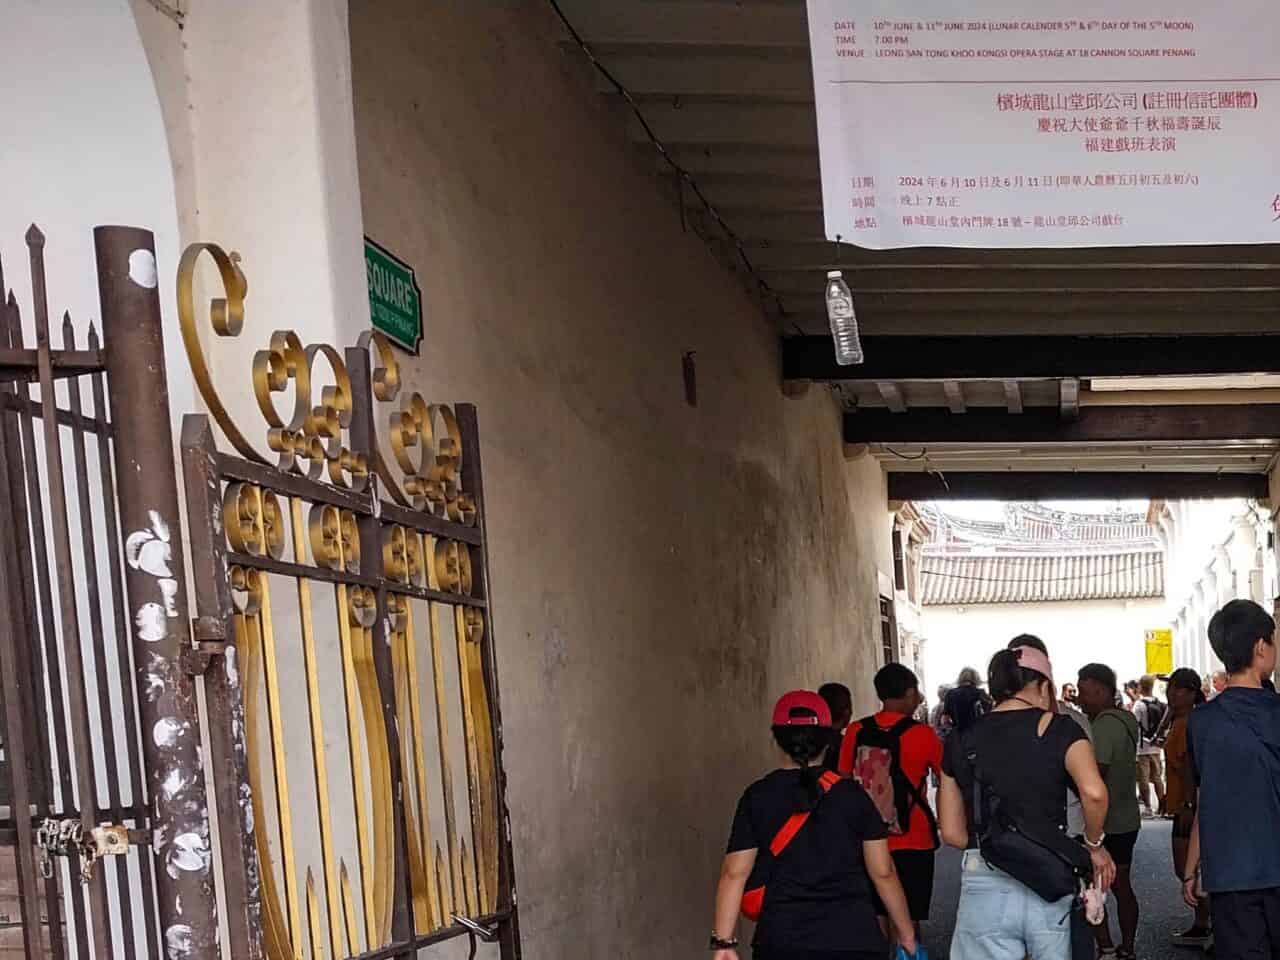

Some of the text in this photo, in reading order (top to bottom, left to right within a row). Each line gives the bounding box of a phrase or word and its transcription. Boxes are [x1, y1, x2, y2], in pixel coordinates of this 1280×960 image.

[834, 22, 856, 31] DATE
[893, 22, 913, 31] JUNE
[944, 22, 964, 31] JUNE
[967, 22, 987, 31] 2024
[1020, 22, 1062, 31] CALENDER
[1101, 22, 1117, 31] DAY
[1120, 22, 1131, 31] OF
[1133, 22, 1147, 31] THE
[1164, 22, 1194, 32] MOON)
[836, 35, 909, 44] TIME 7.00 PM
[837, 49, 865, 58] VENUE
[875, 49, 904, 58] LEONG
[906, 49, 923, 58] SAN
[926, 49, 949, 58] TONG
[951, 49, 975, 58] KHOO
[976, 49, 1008, 58] KONGSI
[1009, 49, 1037, 58] OPERA
[1039, 49, 1064, 58] STAGE
[1066, 49, 1077, 58] AT
[1090, 49, 1126, 58] CANNON
[1128, 49, 1160, 58] SQUARE
[1162, 49, 1196, 58] PENANG
[899, 176, 923, 187] 2024
